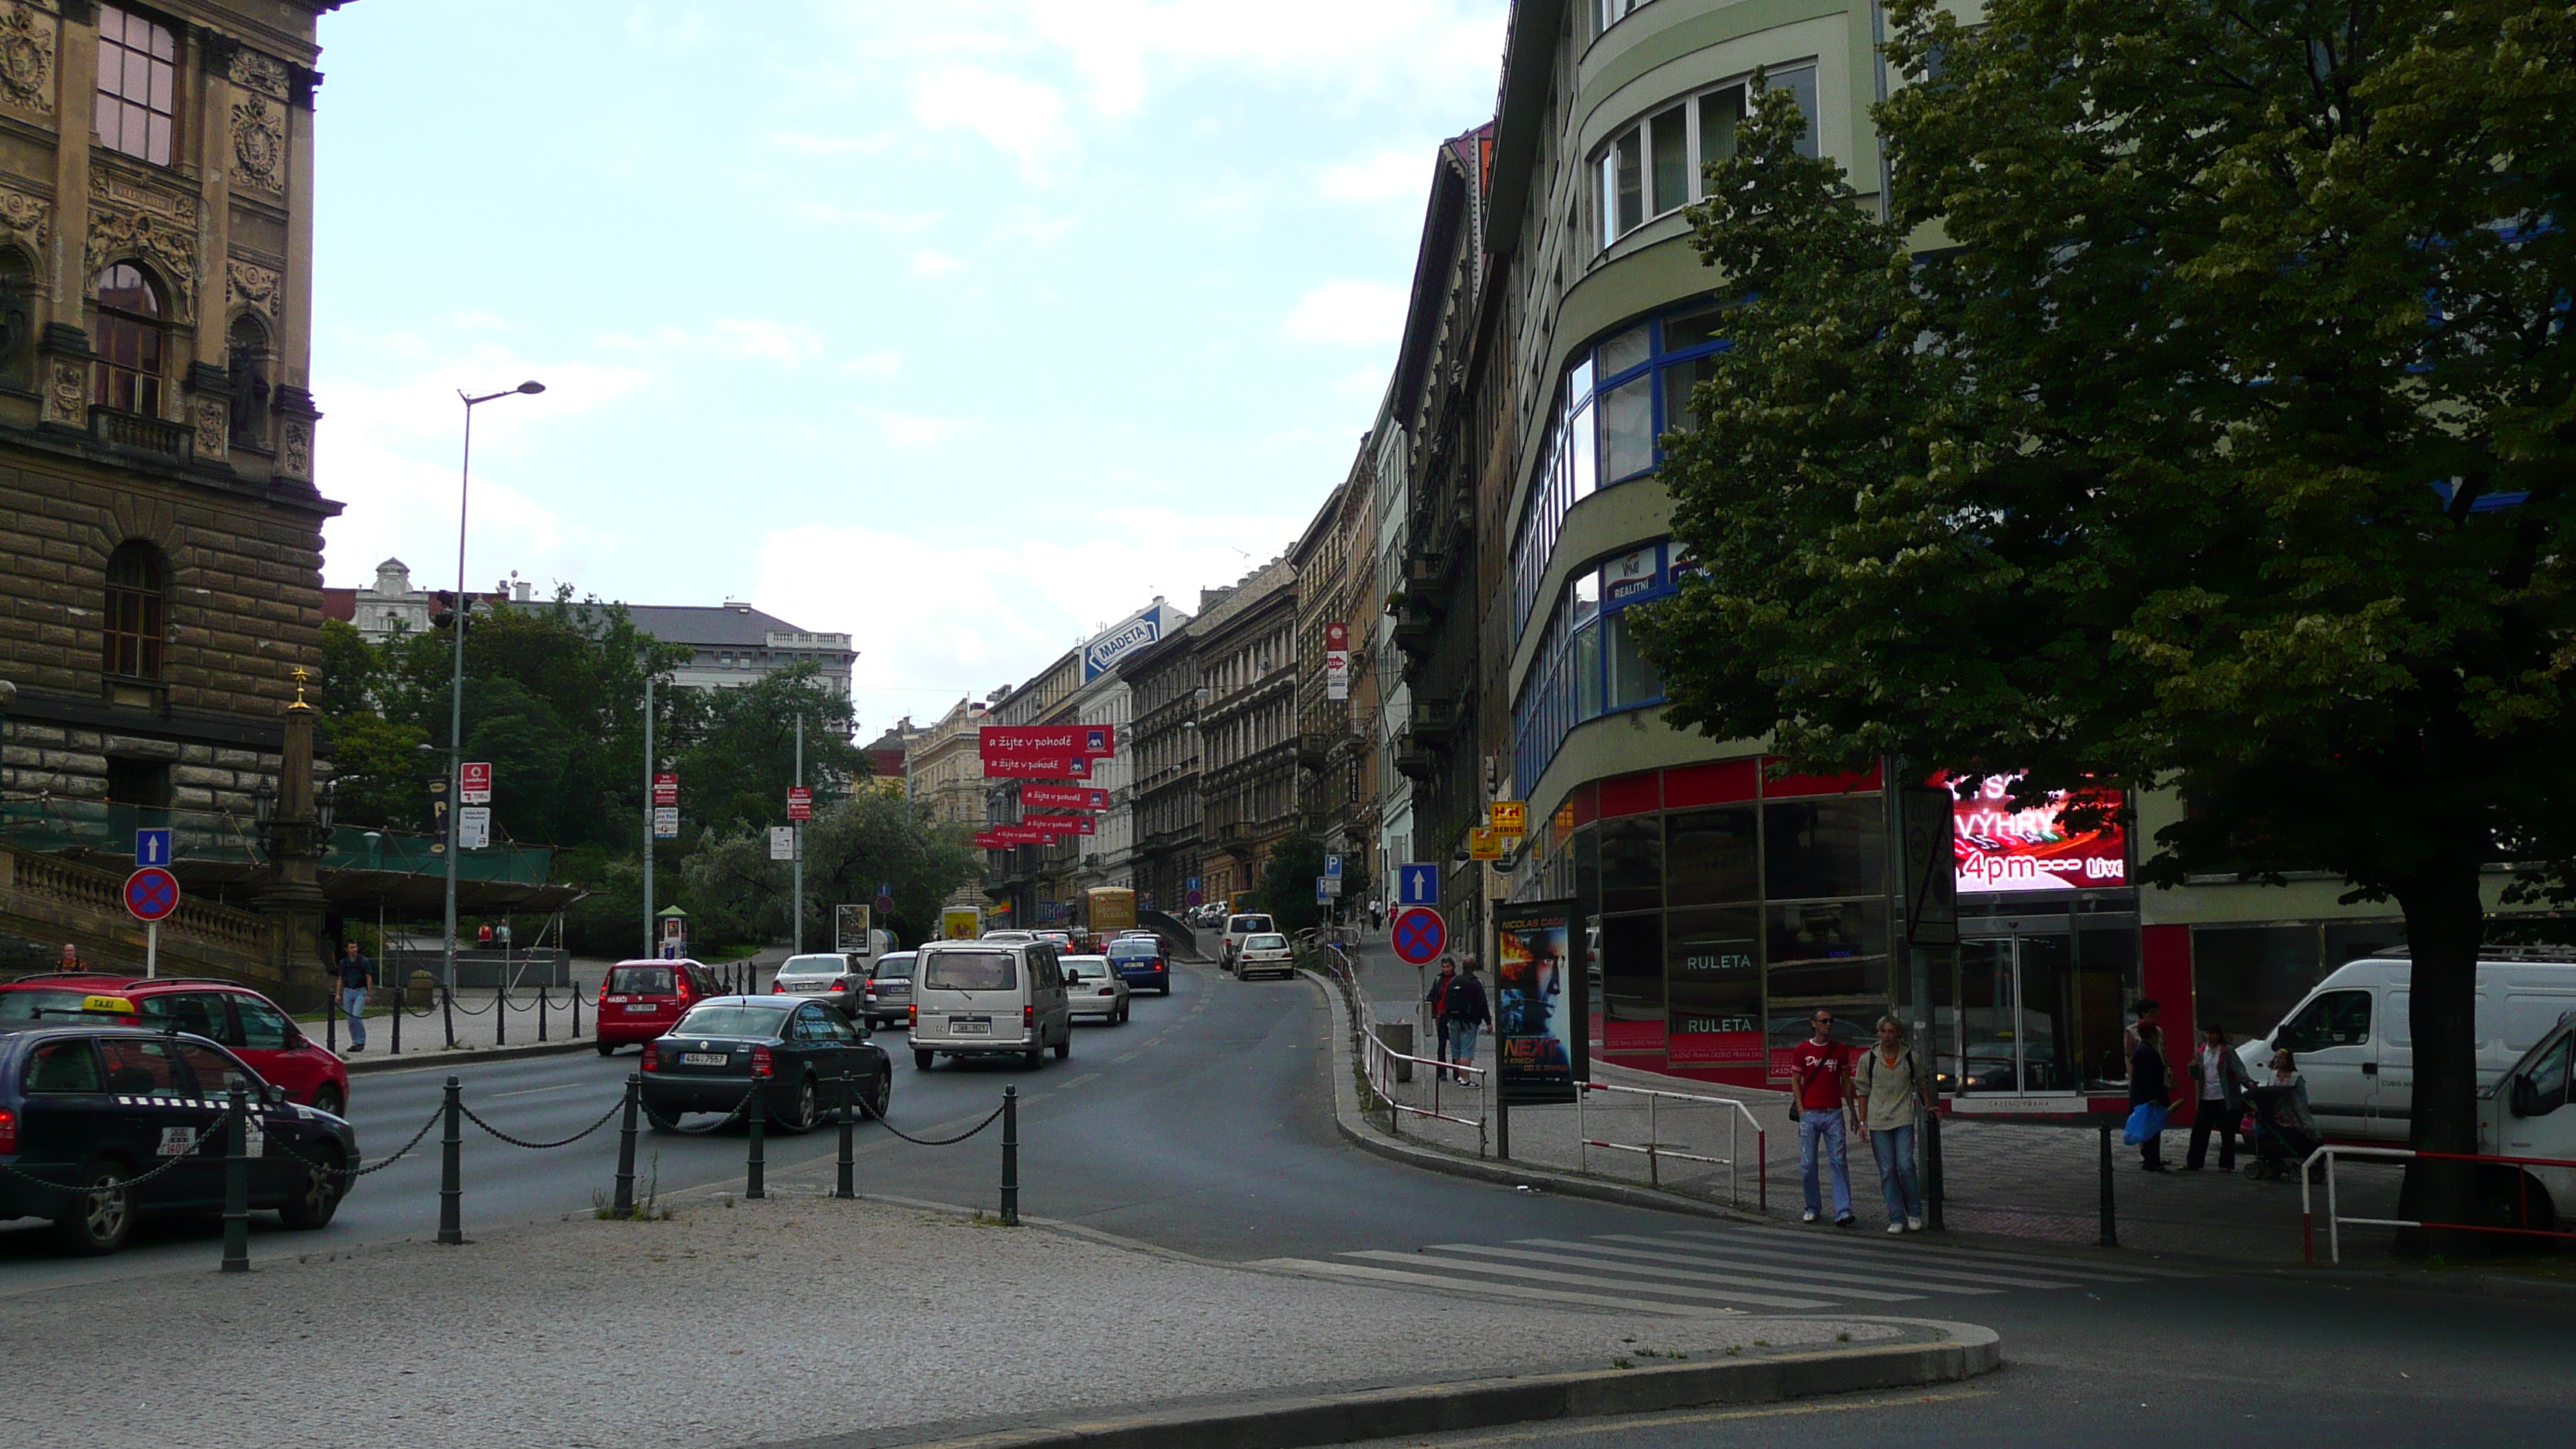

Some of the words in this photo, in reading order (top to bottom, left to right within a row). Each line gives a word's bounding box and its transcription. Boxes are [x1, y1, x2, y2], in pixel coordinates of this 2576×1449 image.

[1615, 578, 1649, 600] REALITNÍ
[1098, 626, 1146, 659] MADETA
[989, 738, 996, 747] a
[999, 735, 1023, 751] žijte
[1026, 738, 1033, 747] v
[1034, 735, 1072, 750] pohodě
[1087, 738, 1102, 747] AXA
[999, 759, 1019, 771] žijte
[1029, 759, 1059, 771] pohodě
[1033, 790, 1050, 801] žijte
[1057, 793, 1081, 802] pohodě
[1954, 807, 2054, 840] VÝHRY
[1329, 857, 1338, 870] P
[1502, 918, 1539, 930] NICOLAS
[1687, 954, 1752, 970] RULETA
[94, 999, 115, 1009] TAXI
[1688, 1019, 1752, 1033] RULETA
[1504, 1038, 1560, 1057] NEXT
[686, 1053, 700, 1062] 4S4
[705, 1053, 724, 1064] 7557
